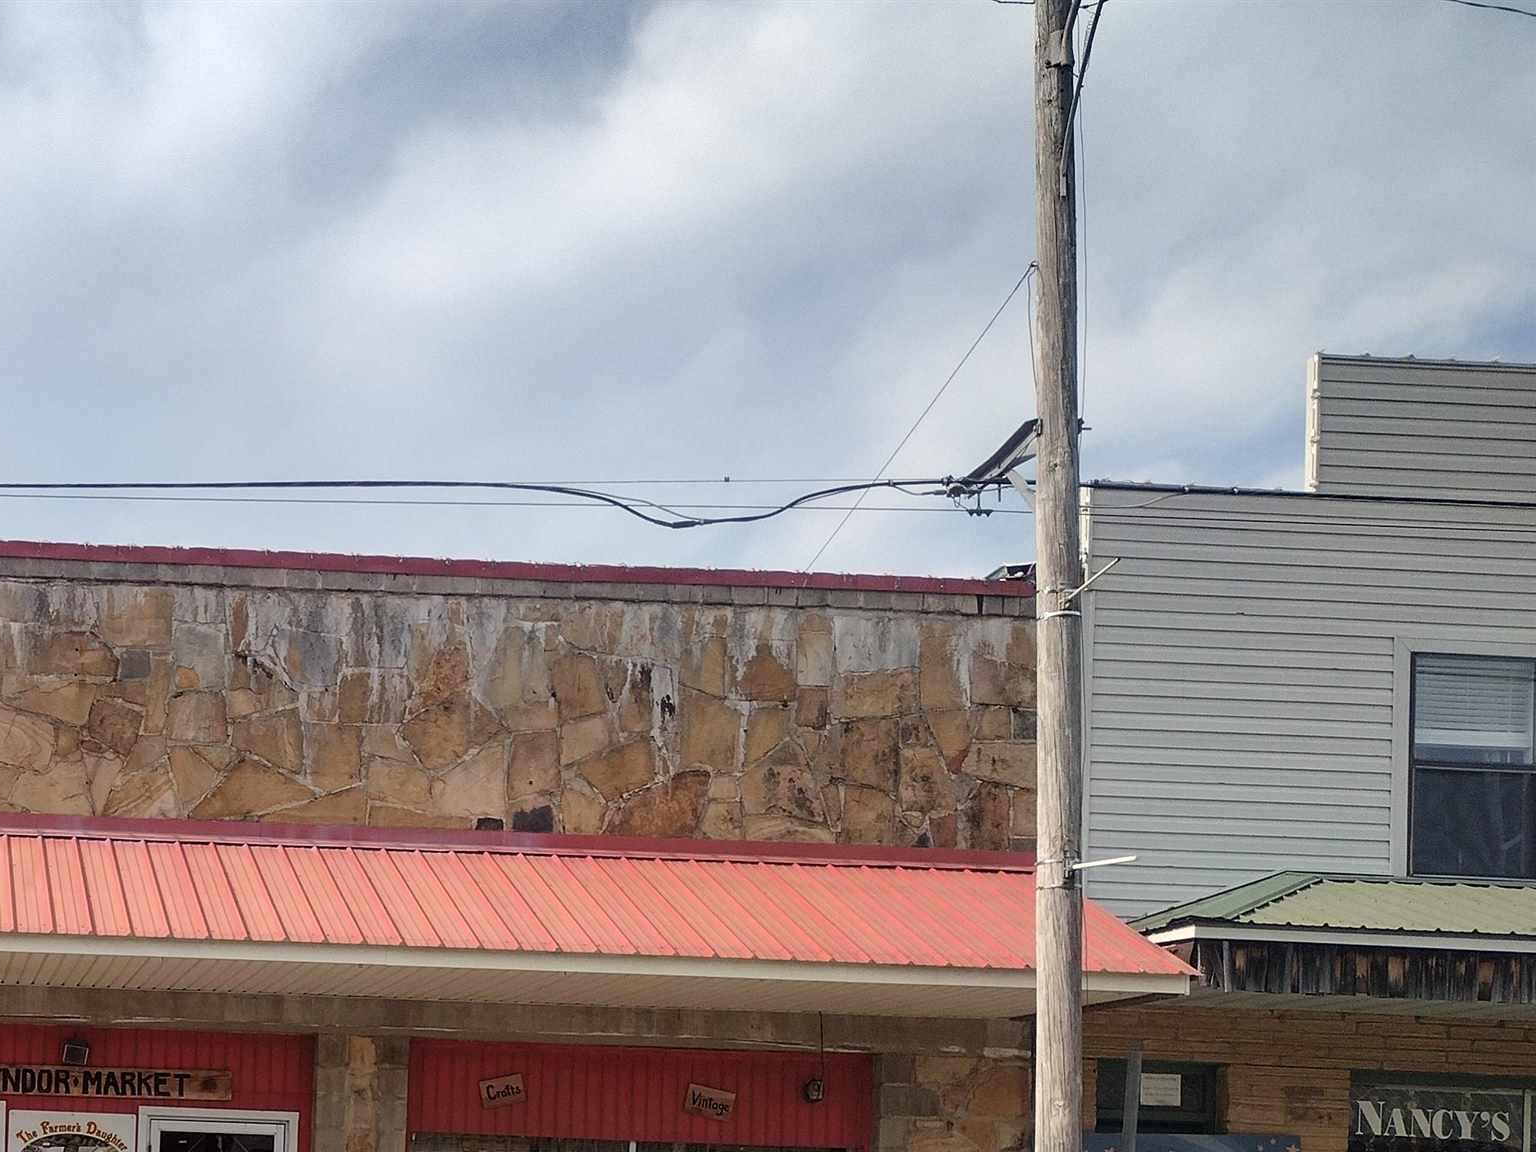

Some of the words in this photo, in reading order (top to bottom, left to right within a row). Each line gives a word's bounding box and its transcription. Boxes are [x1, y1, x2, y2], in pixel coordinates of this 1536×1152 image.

[82, 1071, 191, 1098] MARKET
[486, 1084, 521, 1101] Crafts
[692, 1089, 730, 1117] Vintage
[1354, 1099, 1511, 1142] NANCY'S
[16, 1130, 38, 1144] The
[40, 1120, 81, 1135] Farmer's
[86, 1121, 128, 1151] Daughter
